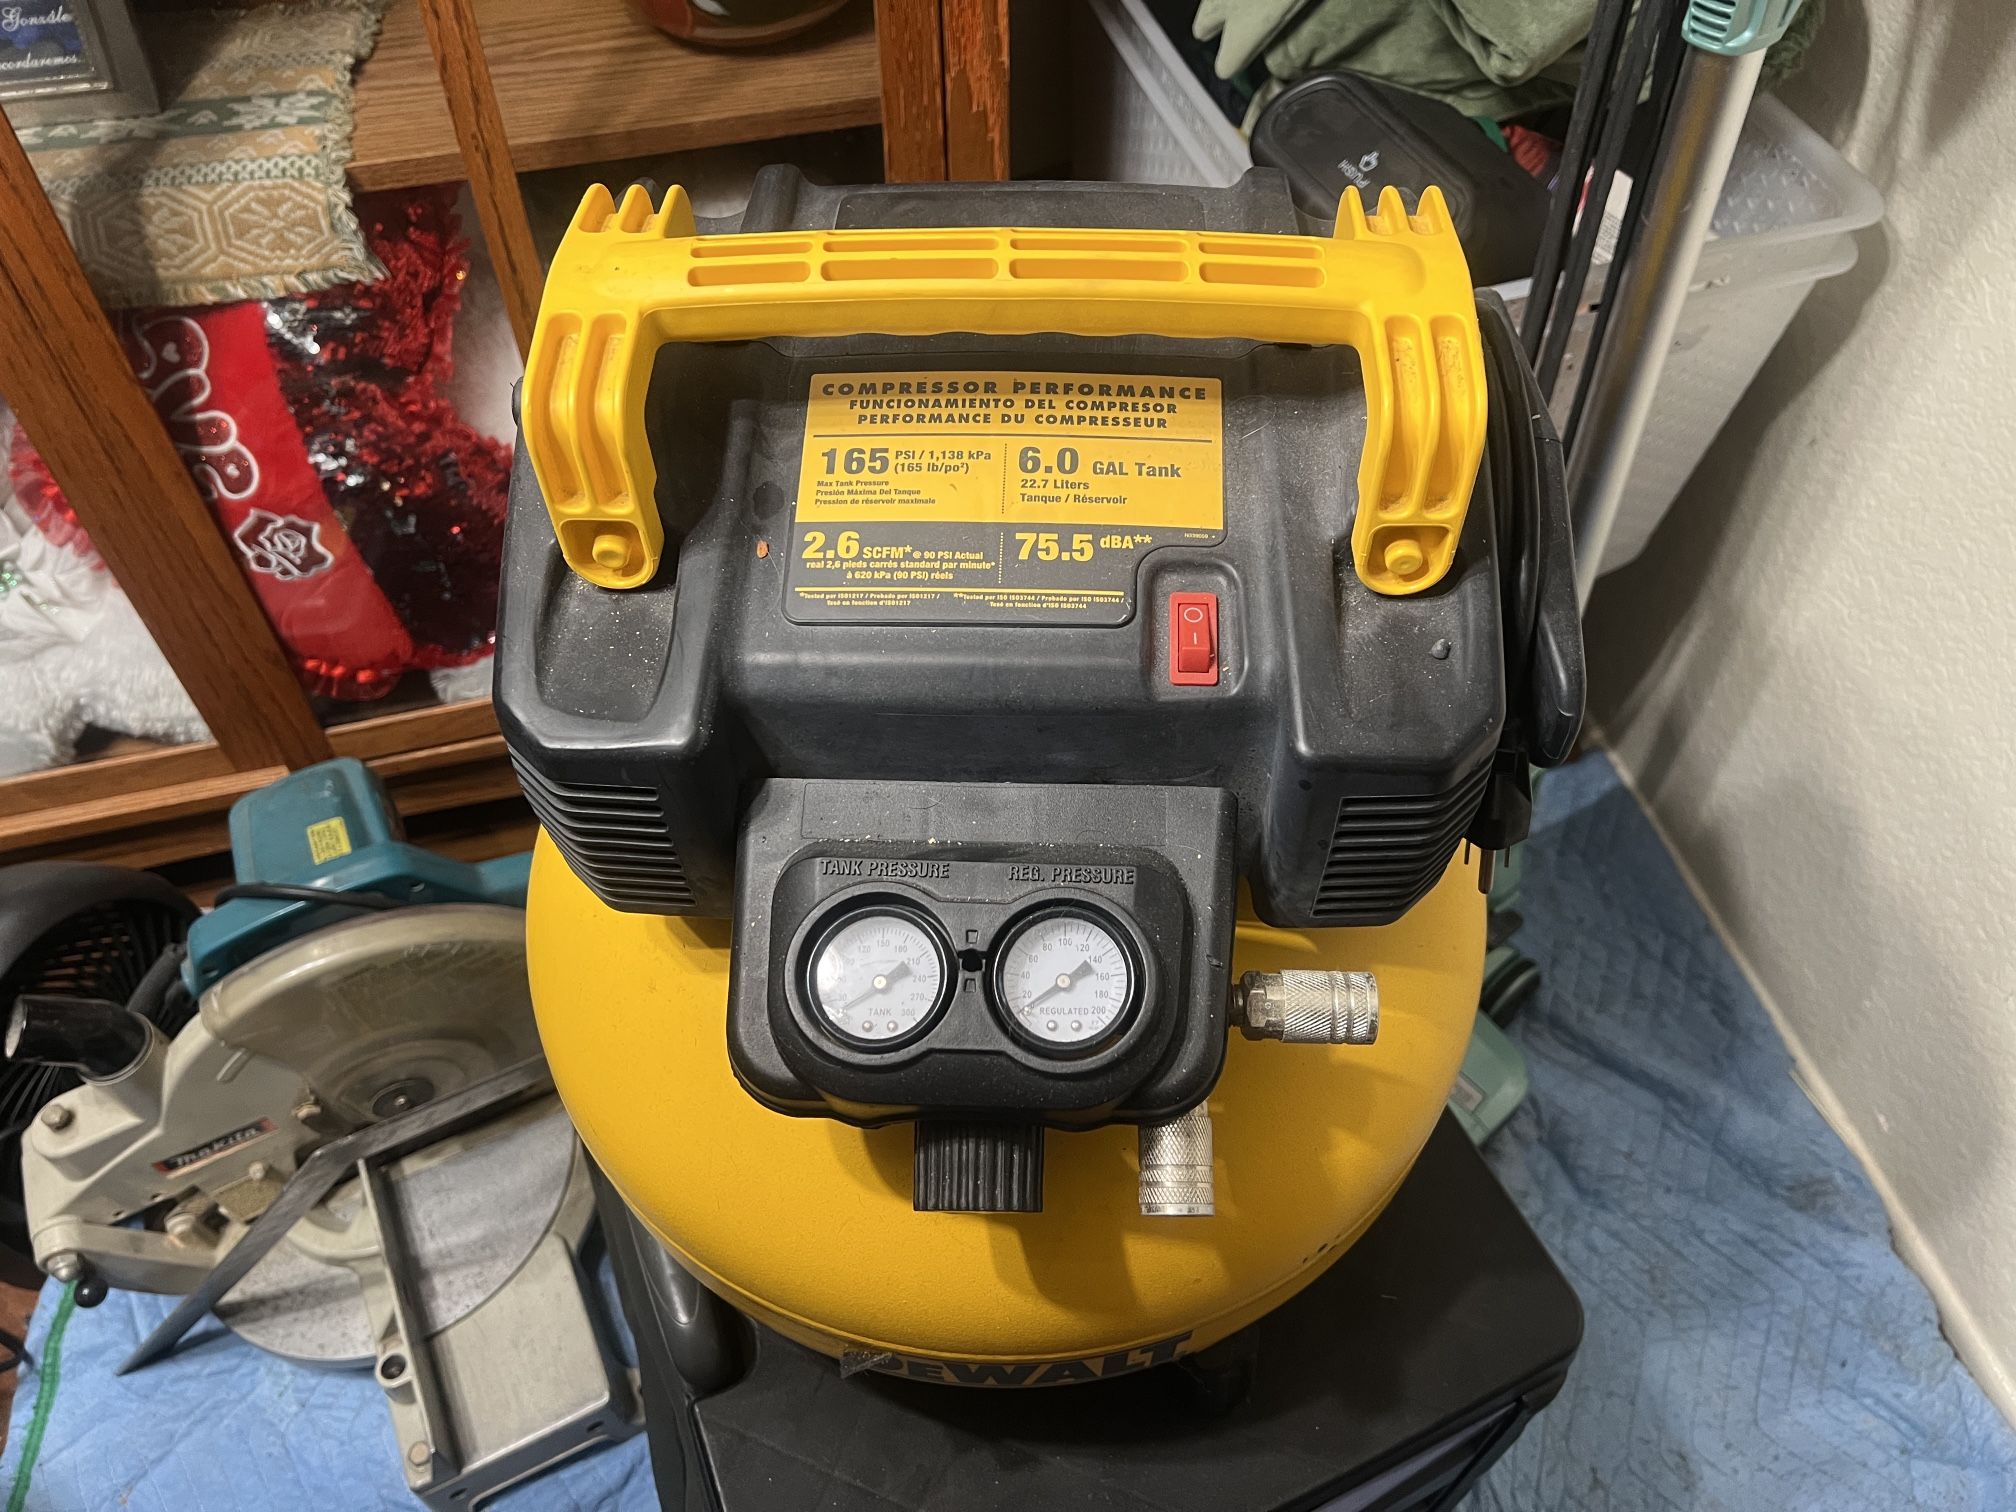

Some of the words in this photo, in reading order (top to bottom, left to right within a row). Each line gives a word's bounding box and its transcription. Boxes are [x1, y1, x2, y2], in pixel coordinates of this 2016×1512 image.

[2, 5, 73, 32] Gonzále
[822, 381, 998, 396] COMPRESSOR
[1012, 381, 1206, 400] PERFORMANCE
[849, 398, 1015, 410] FUNCIONAMIENTO
[1024, 399, 1056, 410] DEL
[1065, 400, 1178, 414] COMPRESOR
[857, 413, 992, 425] PERFORMANCE
[1001, 414, 1025, 424] DU
[1034, 414, 1168, 429] COMPRESSEUR
[895, 450, 915, 460] PSI
[918, 450, 925, 460] /
[928, 450, 964, 462] 1,138
[968, 450, 992, 460] kPa
[821, 447, 890, 475] 165
[1018, 446, 1080, 475] 6.0
[1092, 461, 1129, 476] GAL
[1134, 462, 1182, 478] Tank
[894, 462, 922, 474] (165
[926, 462, 970, 475] lb/po²)
[1020, 479, 1049, 489] 22.7
[1053, 479, 1090, 490] Liters
[816, 488, 845, 496] Presión
[846, 488, 877, 496] Máxima
[879, 488, 892, 496] Del
[894, 488, 921, 497] Tanque
[861, 497, 896, 505] réservoir
[1020, 493, 1062, 504] Tanque
[1064, 493, 1070, 503] /
[1073, 493, 1128, 505] Réservoir
[802, 530, 860, 559] 2.6
[1015, 532, 1095, 562] 75.5
[913, 551, 922, 560] @
[923, 551, 936, 559] 90
[938, 551, 953, 559] PSI
[954, 551, 984, 560] Actual
[806, 560, 824, 569] real
[826, 561, 840, 569] 2,6
[842, 561, 867, 570] pieds
[869, 561, 898, 569] carrés
[900, 560, 941, 569] standard
[942, 562, 957, 570] par
[854, 571, 872, 579] 620
[874, 571, 891, 579] kPa
[893, 571, 909, 580] (90
[910, 571, 929, 581] PSI)
[931, 571, 954, 580] réels
[820, 859, 863, 876] TANK
[867, 859, 950, 879] PRESSURE
[1008, 865, 1046, 882] REG.
[1051, 866, 1136, 885] PRESSURE
[1058, 938, 1072, 946] 100
[1042, 943, 1053, 951] 80
[1076, 944, 1090, 952] 120
[906, 957, 920, 965] 210
[1088, 956, 1103, 964] 140
[912, 975, 927, 983] 240
[1095, 973, 1110, 981] 160
[910, 992, 925, 1000] 270
[1022, 991, 1032, 999] 20
[1094, 990, 1109, 998] 180
[868, 1008, 892, 1016] TANK
[901, 1008, 916, 1016] 300
[1039, 1007, 1089, 1016] REGULATED
[1091, 1006, 1106, 1015] 200
